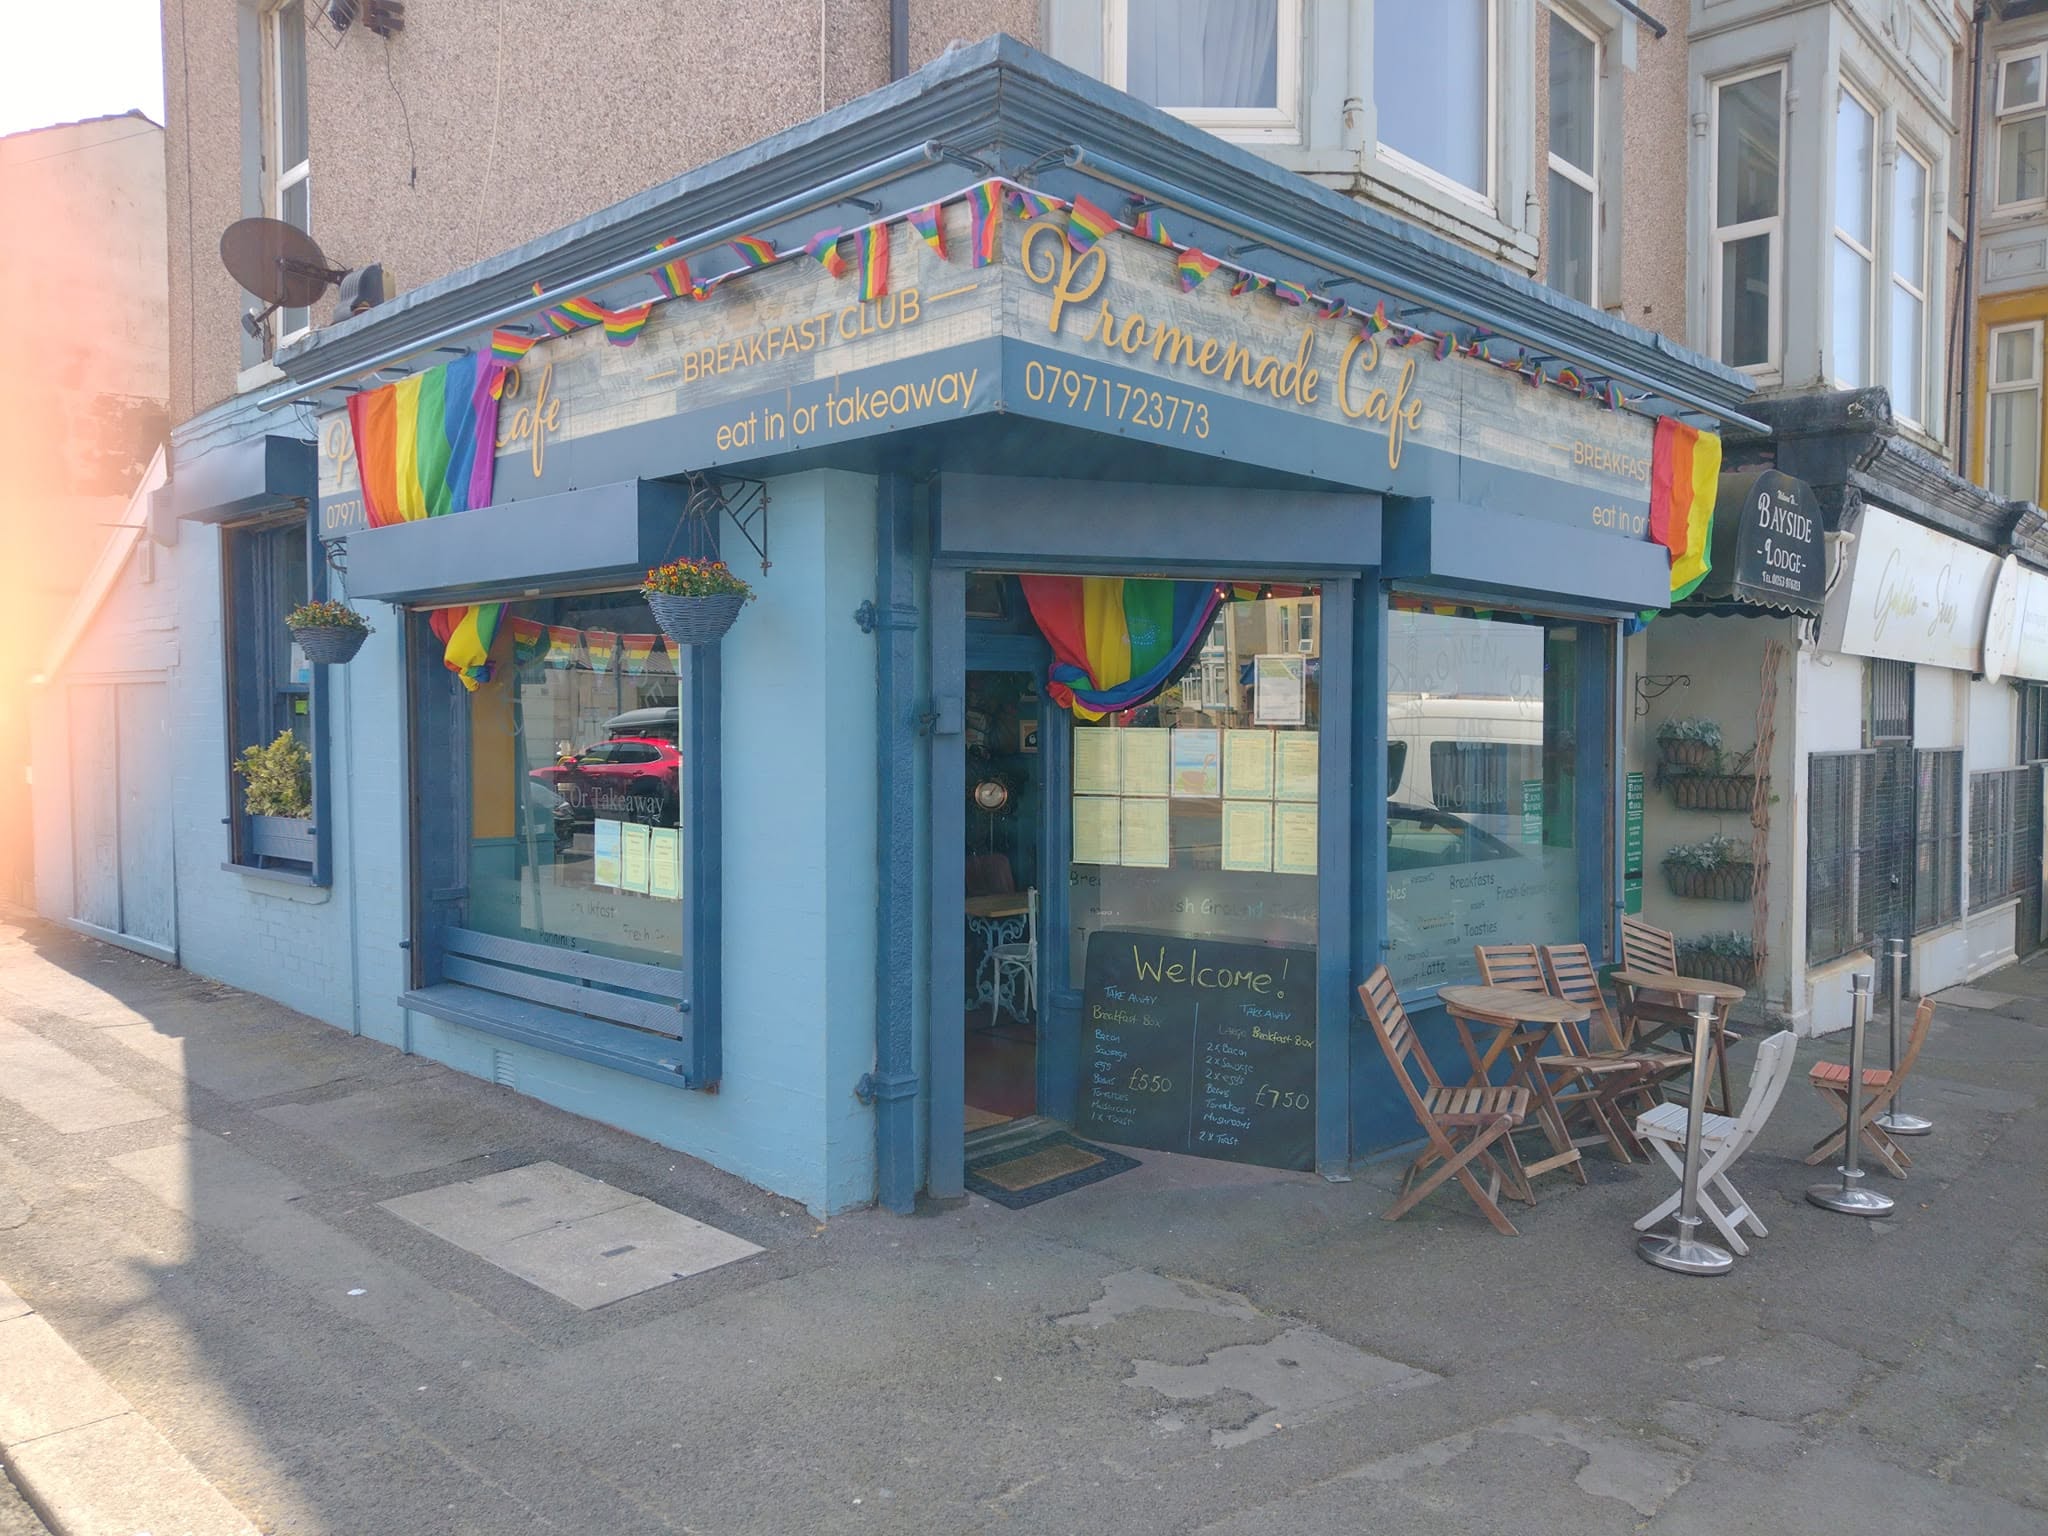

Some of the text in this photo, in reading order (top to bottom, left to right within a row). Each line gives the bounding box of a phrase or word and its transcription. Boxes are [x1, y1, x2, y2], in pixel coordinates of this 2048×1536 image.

[683, 288, 920, 383] BREAKFAST CLUB
[1021, 222, 1424, 470] Promenade Cafe
[716, 368, 979, 452] eat in or takeaway
[1025, 360, 1210, 440] 07971723773
[1573, 439, 1652, 481] BREAKFAST
[326, 498, 366, 529] 07971
[1592, 505, 1645, 534] eat in or
[1757, 492, 1813, 543] BAYSIDE
[571, 786, 589, 809] Or
[592, 787, 665, 819] Takeaway
[1449, 872, 1495, 890] Breakfasts
[1463, 920, 1498, 937] Toasties
[1133, 944, 1290, 999] Welcome!
[1421, 959, 1447, 977] Latte
[1294, 1034, 1315, 1049] Box
[1216, 1133, 1240, 1146] Toast
